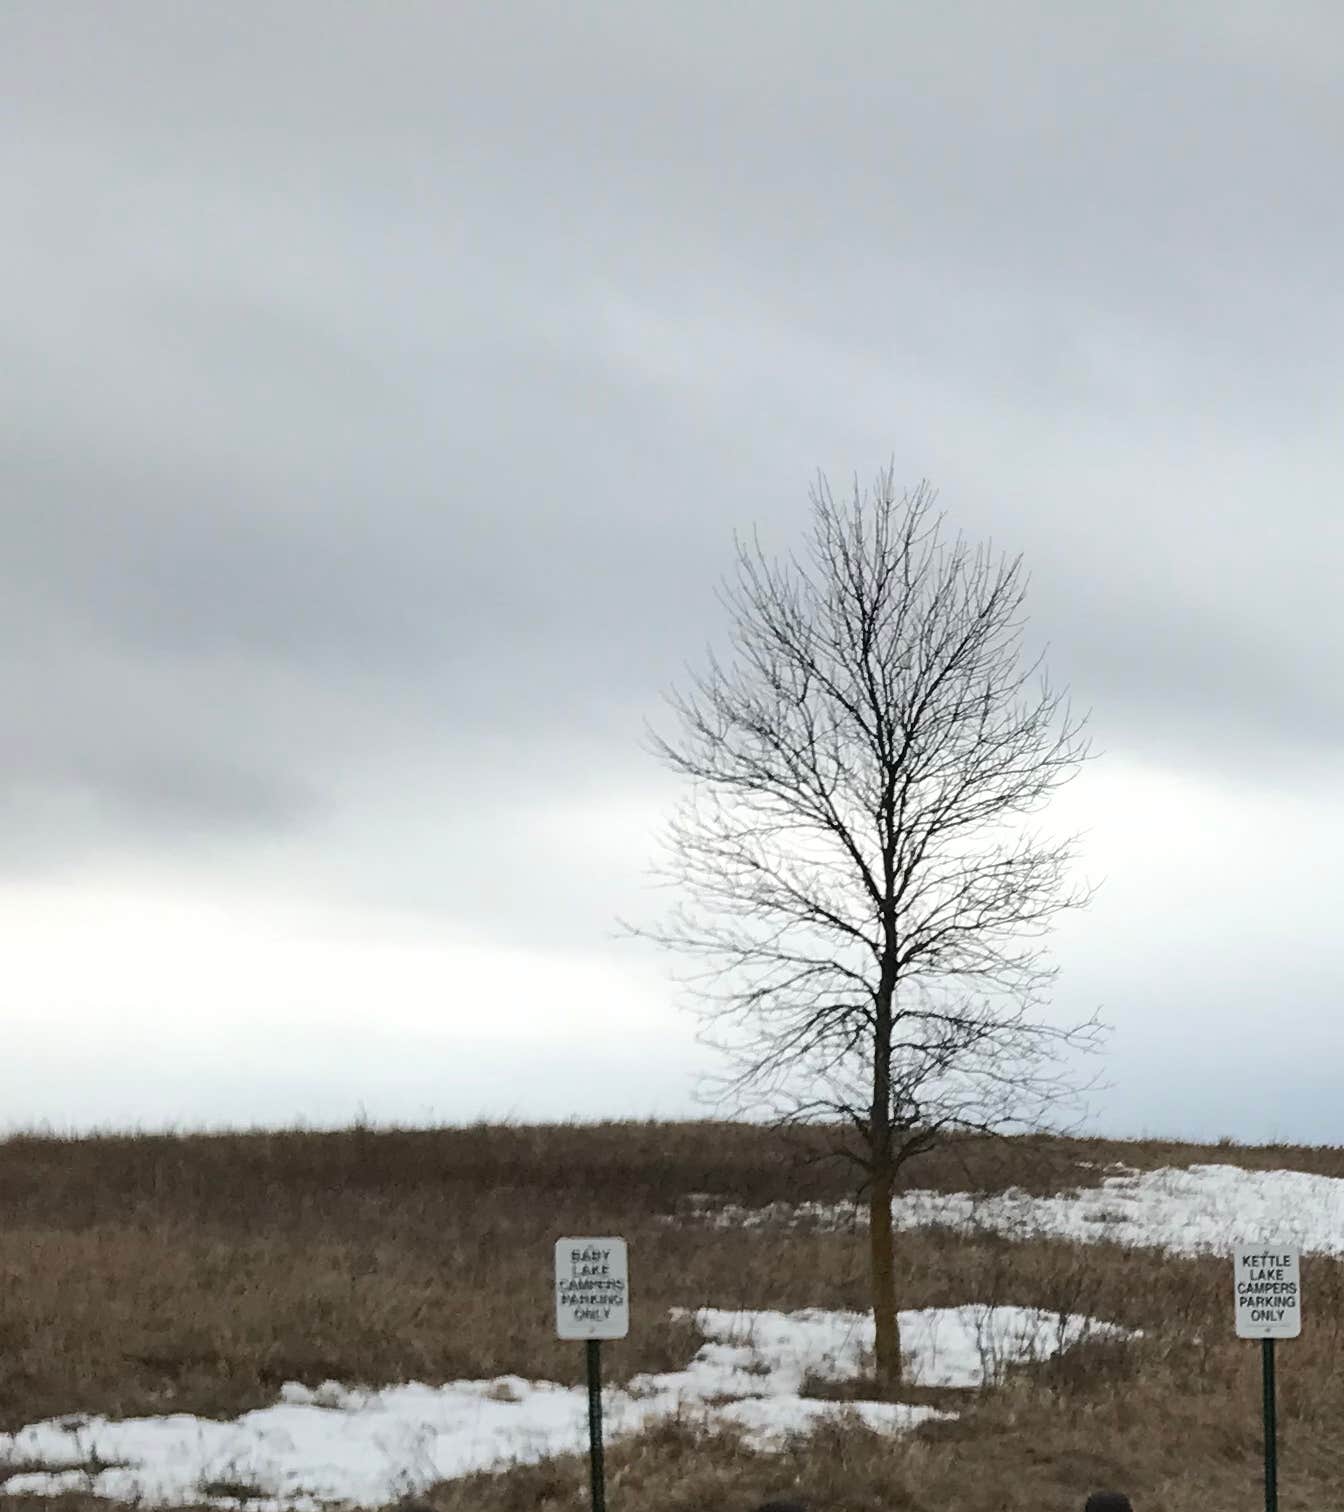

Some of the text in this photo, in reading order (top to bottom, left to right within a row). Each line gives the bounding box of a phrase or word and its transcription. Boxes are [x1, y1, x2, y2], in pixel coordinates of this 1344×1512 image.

[1242, 1255, 1292, 1267] KETTLE
[571, 1263, 609, 1276] LAKE
[1250, 1269, 1284, 1281] LAKE
[1237, 1282, 1297, 1294] CAMPERS
[1239, 1296, 1296, 1308] PARKING
[573, 1308, 611, 1321] ONLY
[1251, 1309, 1284, 1322] ONLY
